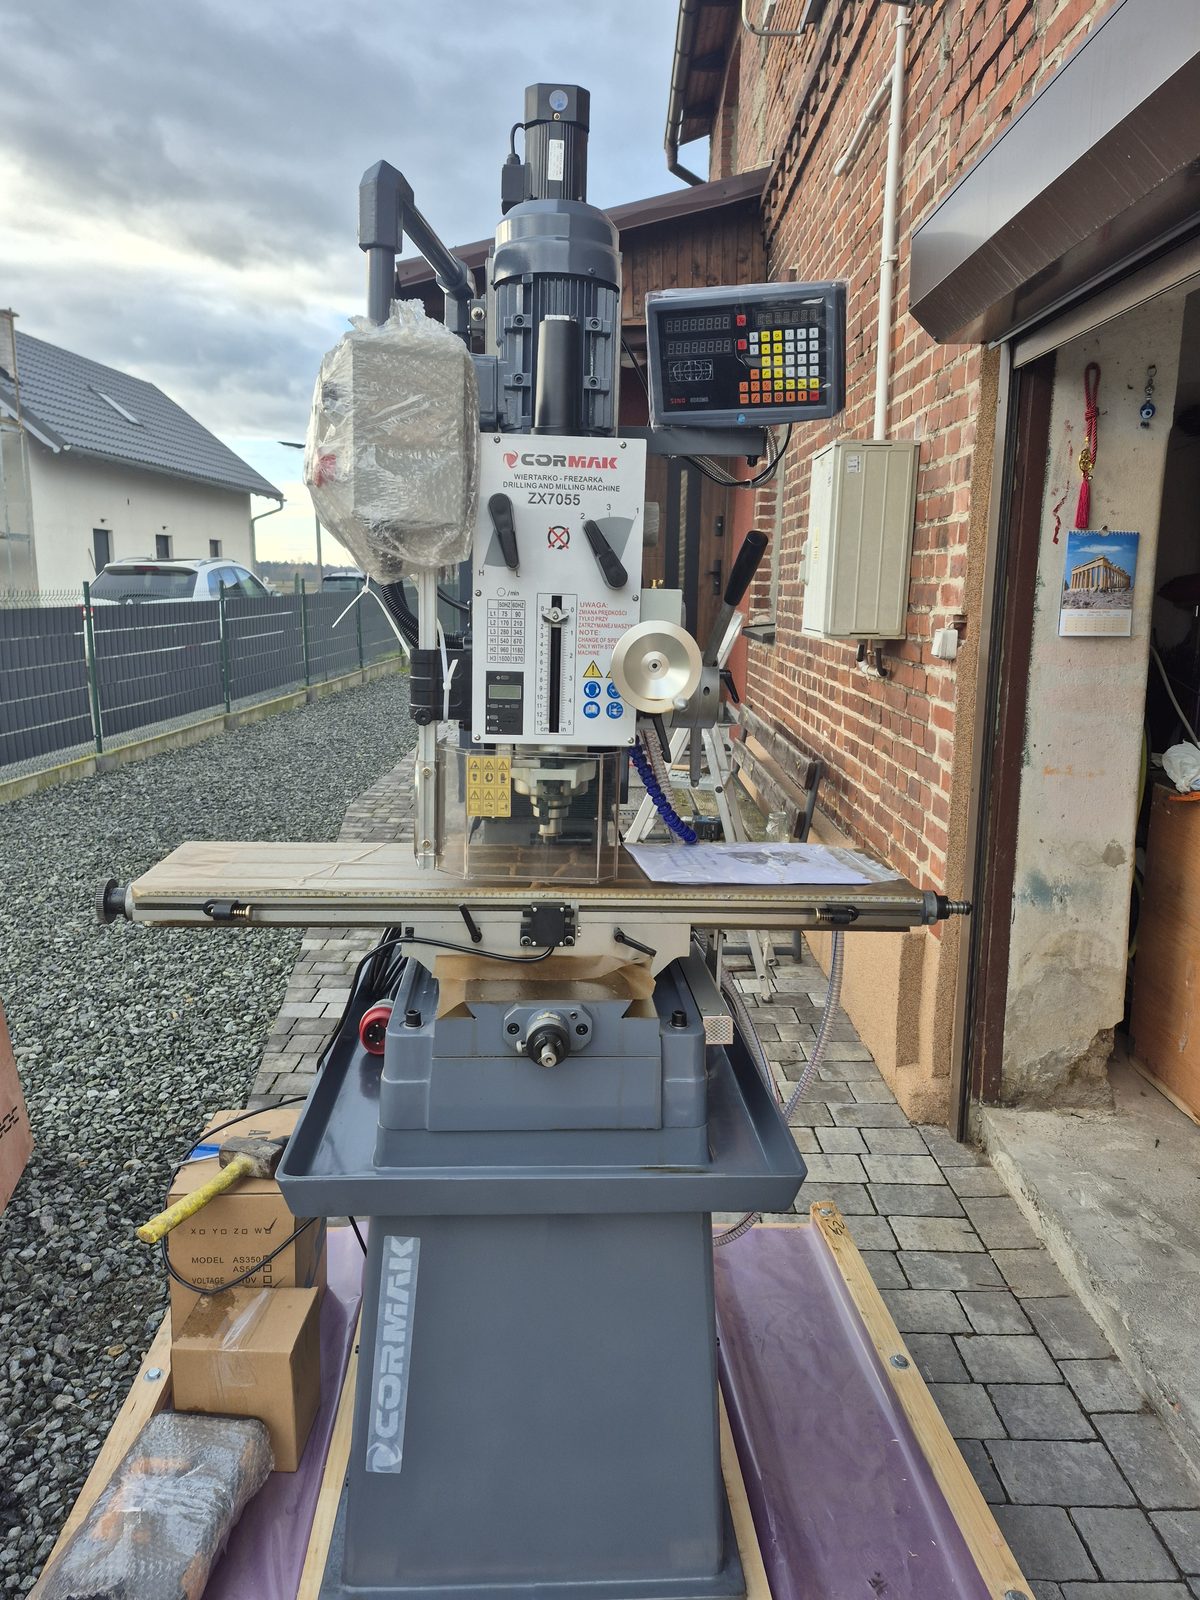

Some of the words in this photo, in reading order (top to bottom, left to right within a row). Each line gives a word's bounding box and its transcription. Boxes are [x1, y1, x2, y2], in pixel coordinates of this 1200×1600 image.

[521, 453, 618, 469] CORMAK
[528, 492, 581, 506] ZX7055
[375, 1236, 414, 1438] CORMAK
